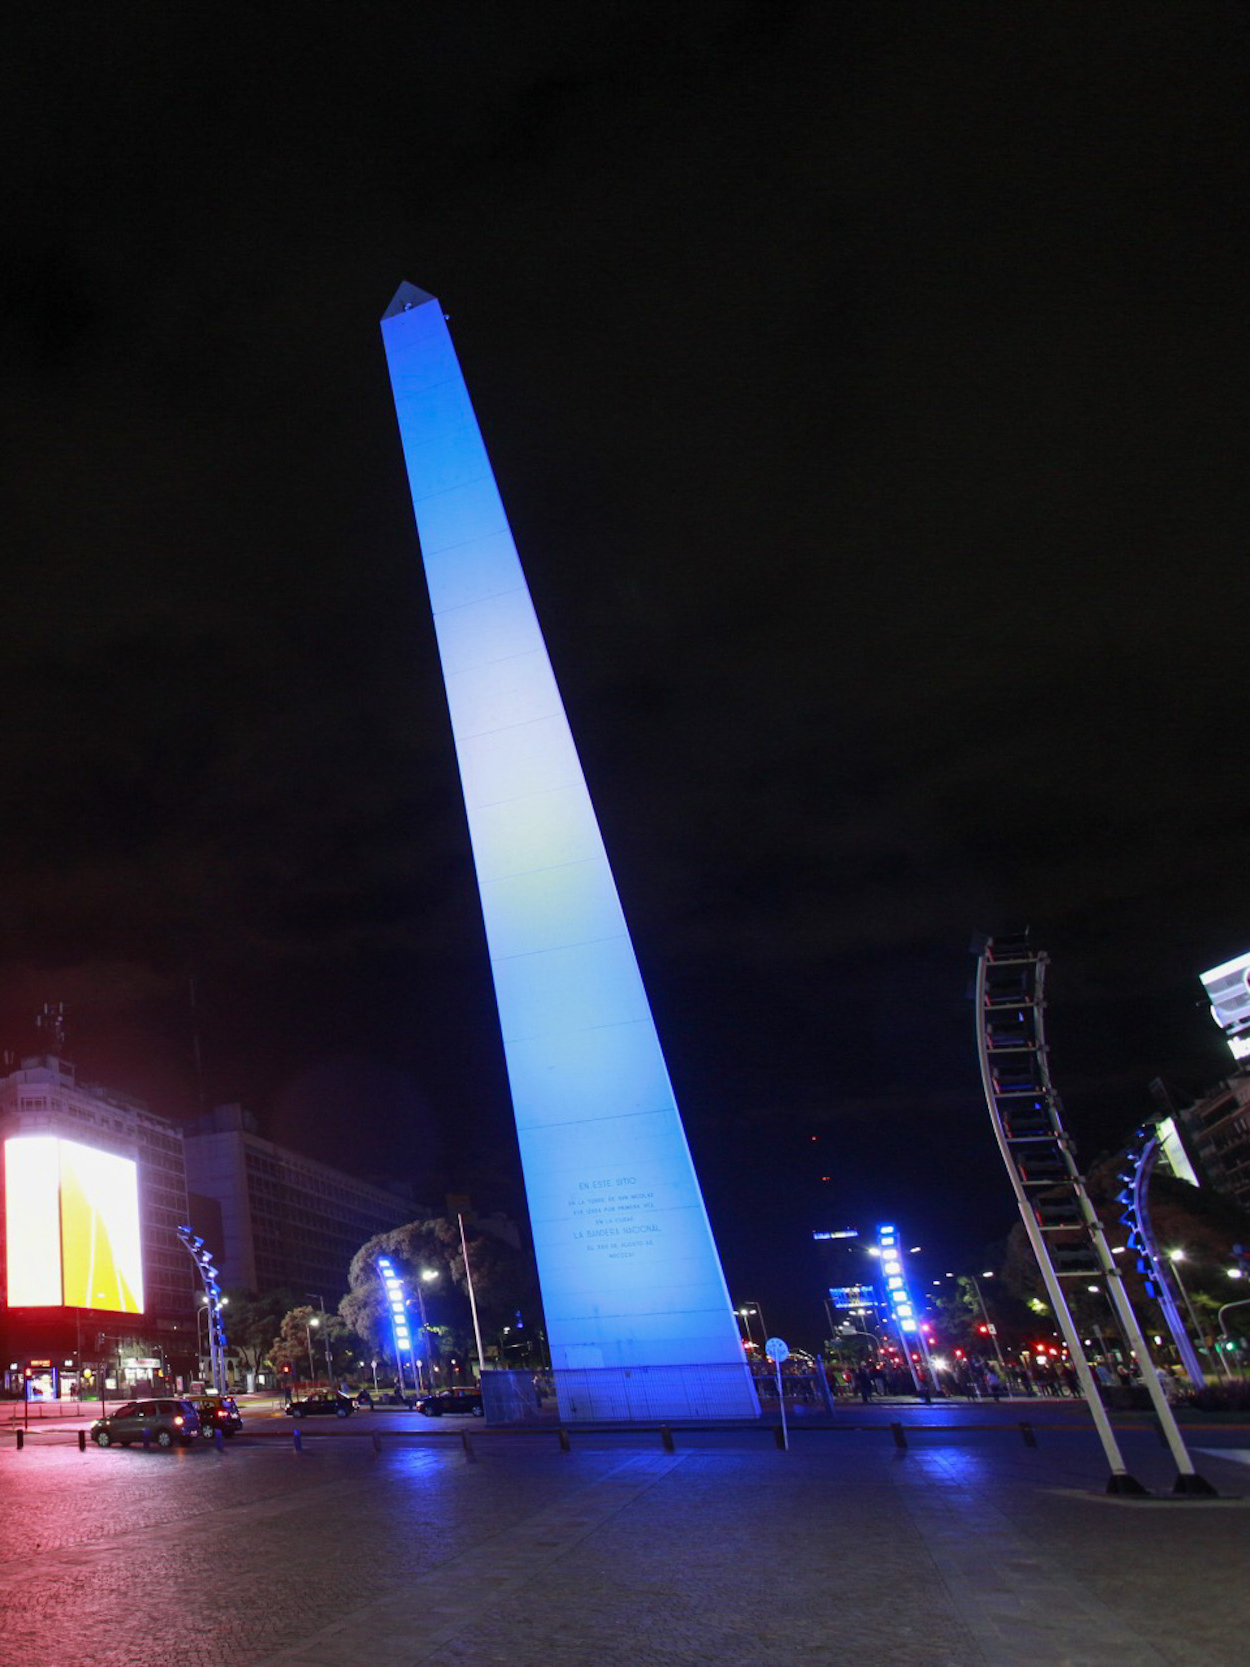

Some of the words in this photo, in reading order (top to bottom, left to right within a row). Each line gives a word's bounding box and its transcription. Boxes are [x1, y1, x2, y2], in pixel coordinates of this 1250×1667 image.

[579, 1182, 589, 1190] EN
[593, 1179, 612, 1189] ESTE
[616, 1176, 637, 1186] SITIO
[586, 1228, 620, 1238] BANDERA
[623, 1224, 662, 1234] NACIONAL
